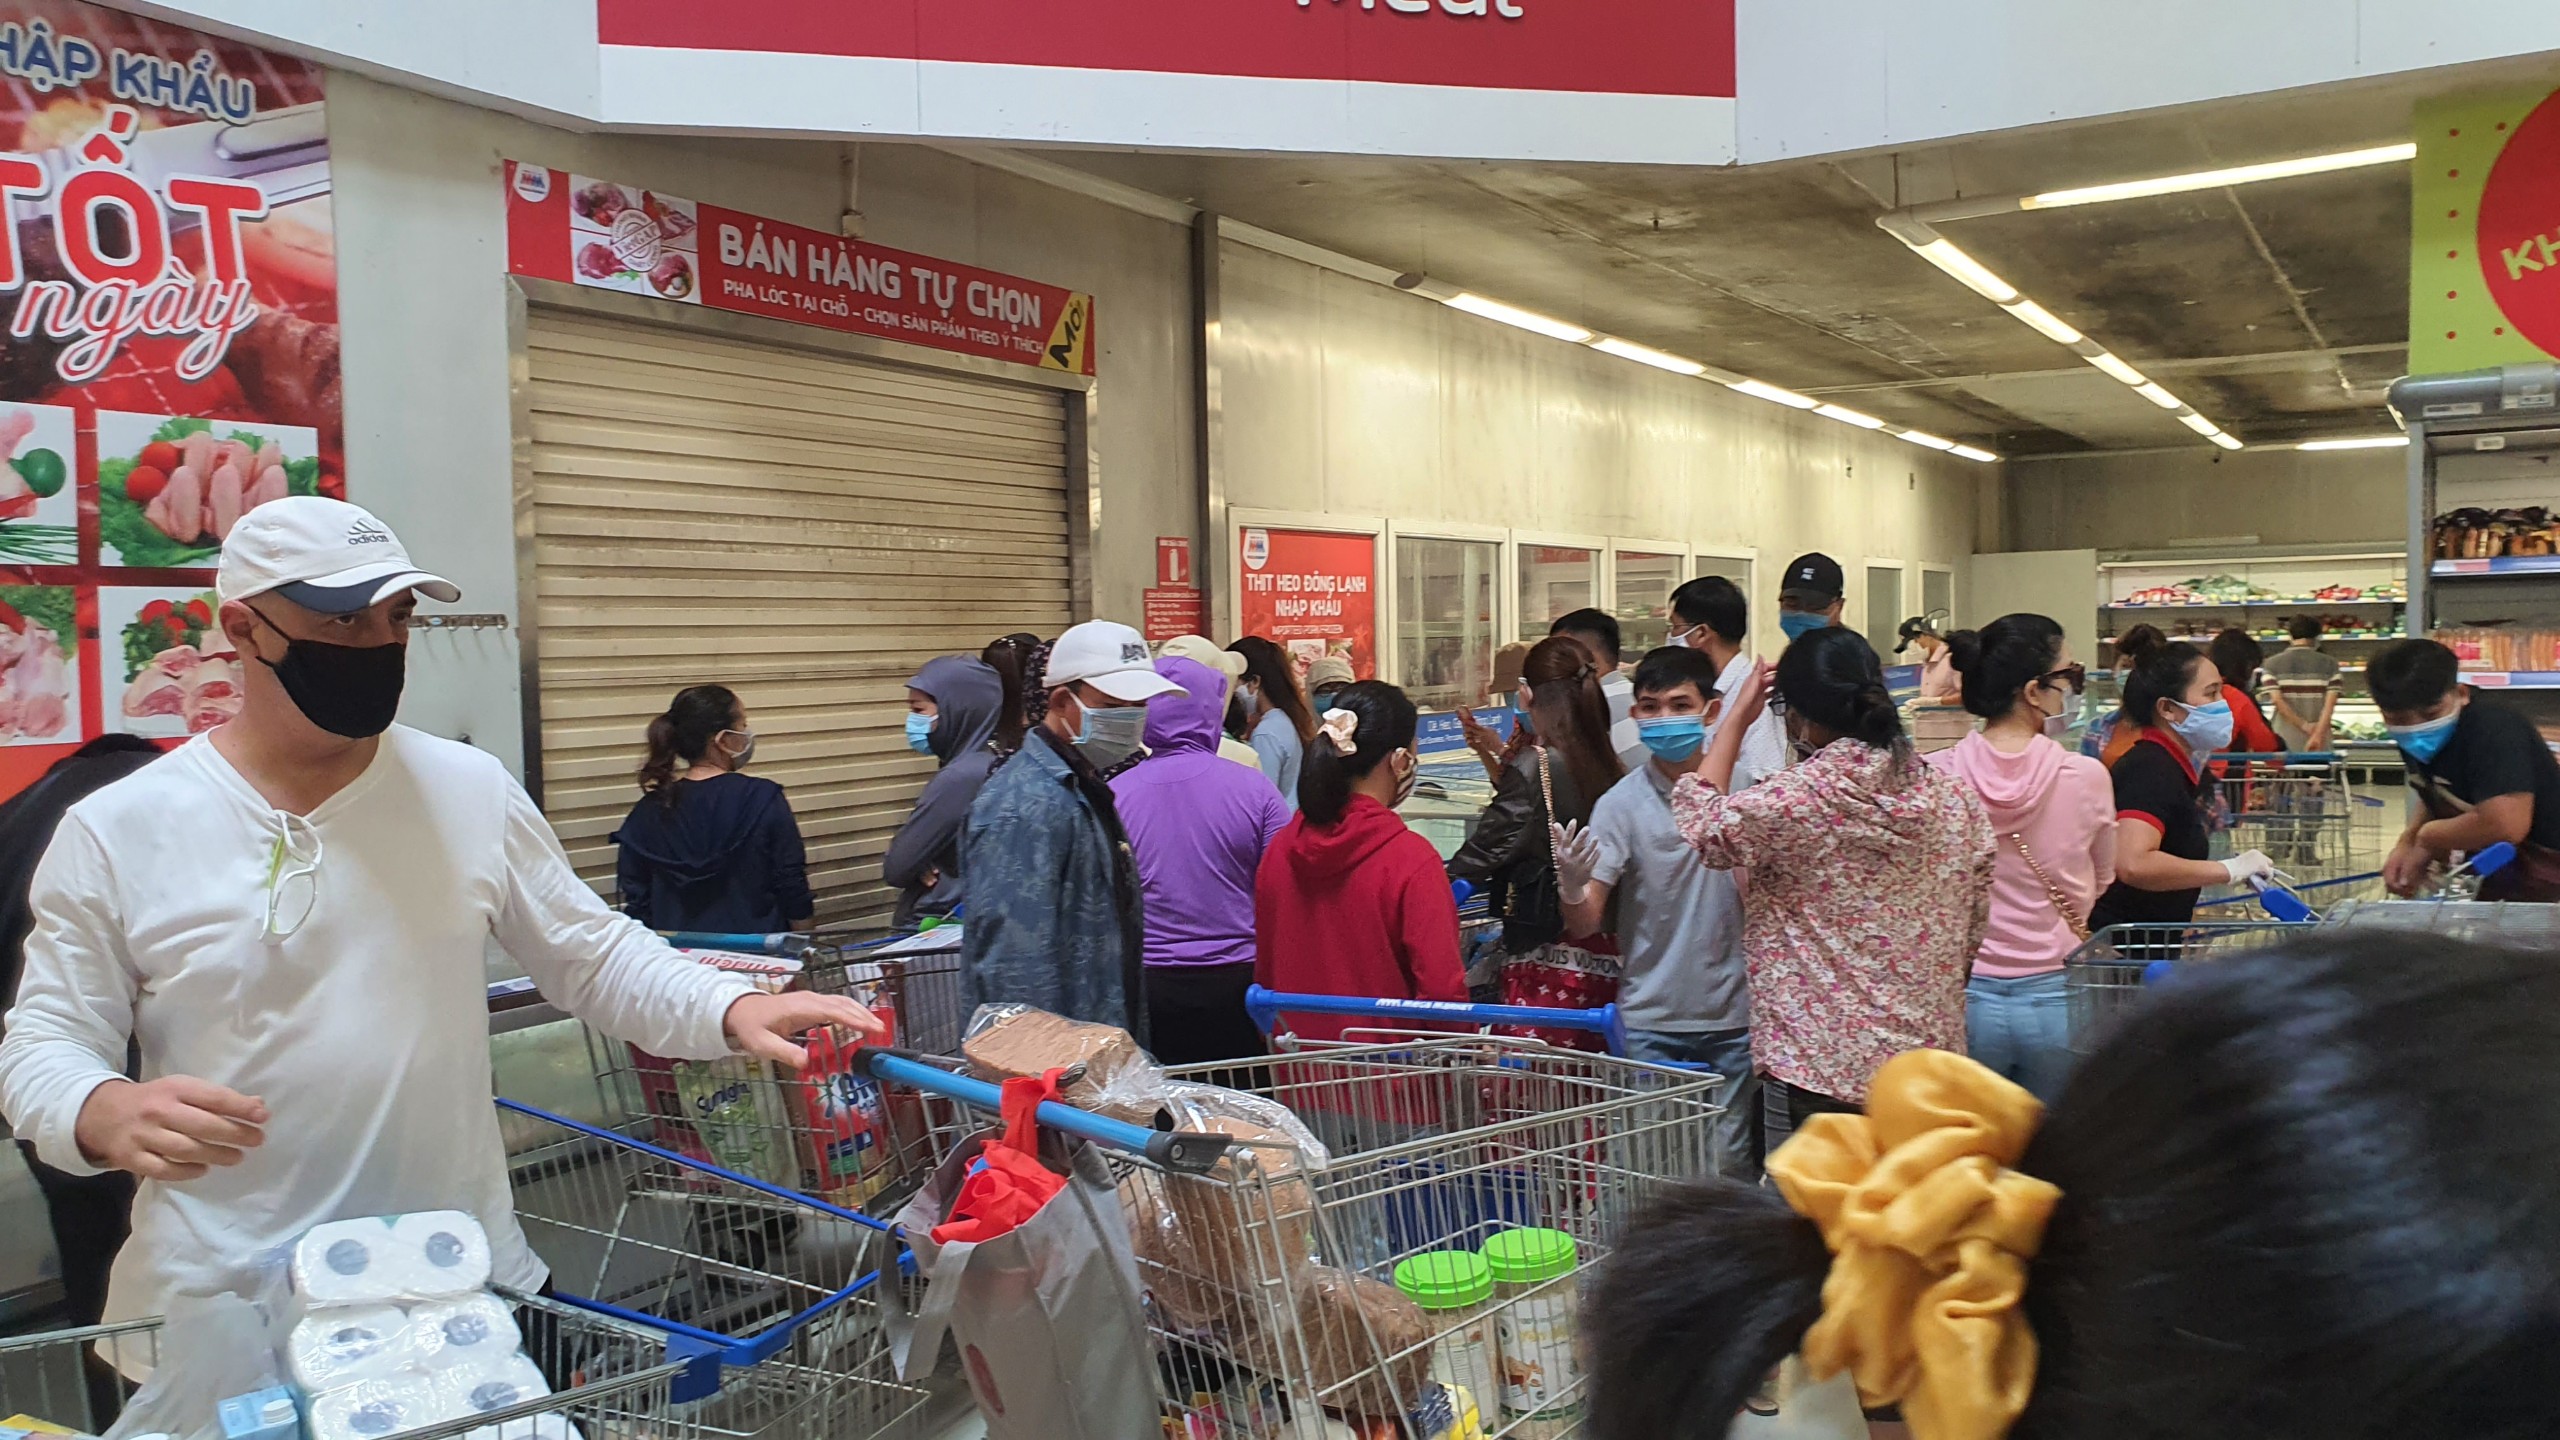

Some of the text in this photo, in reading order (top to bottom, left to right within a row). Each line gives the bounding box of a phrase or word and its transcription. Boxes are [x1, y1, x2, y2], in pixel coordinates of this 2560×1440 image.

[115, 53, 251, 120] KHẨU
[718, 221, 798, 279] BÁN
[807, 240, 902, 300] HÀNG
[910, 266, 958, 319] TỰ
[966, 280, 1042, 333] CHỌN
[10, 257, 259, 380] ngày
[723, 279, 757, 300] PHA
[791, 292, 819, 315] TẠI
[864, 307, 900, 329] CHỌN
[902, 311, 930, 332] SẢN
[930, 316, 967, 341] PHẨM
[968, 327, 1000, 347] THEO
[1001, 331, 1010, 348] Ý
[1012, 335, 1045, 355] THÍCH
[347, 533, 390, 545] adidas
[1246, 570, 1367, 597] THỊT HEO ĐÔNG LẠNH
[1275, 590, 1342, 621] NHẬP KHẨU
